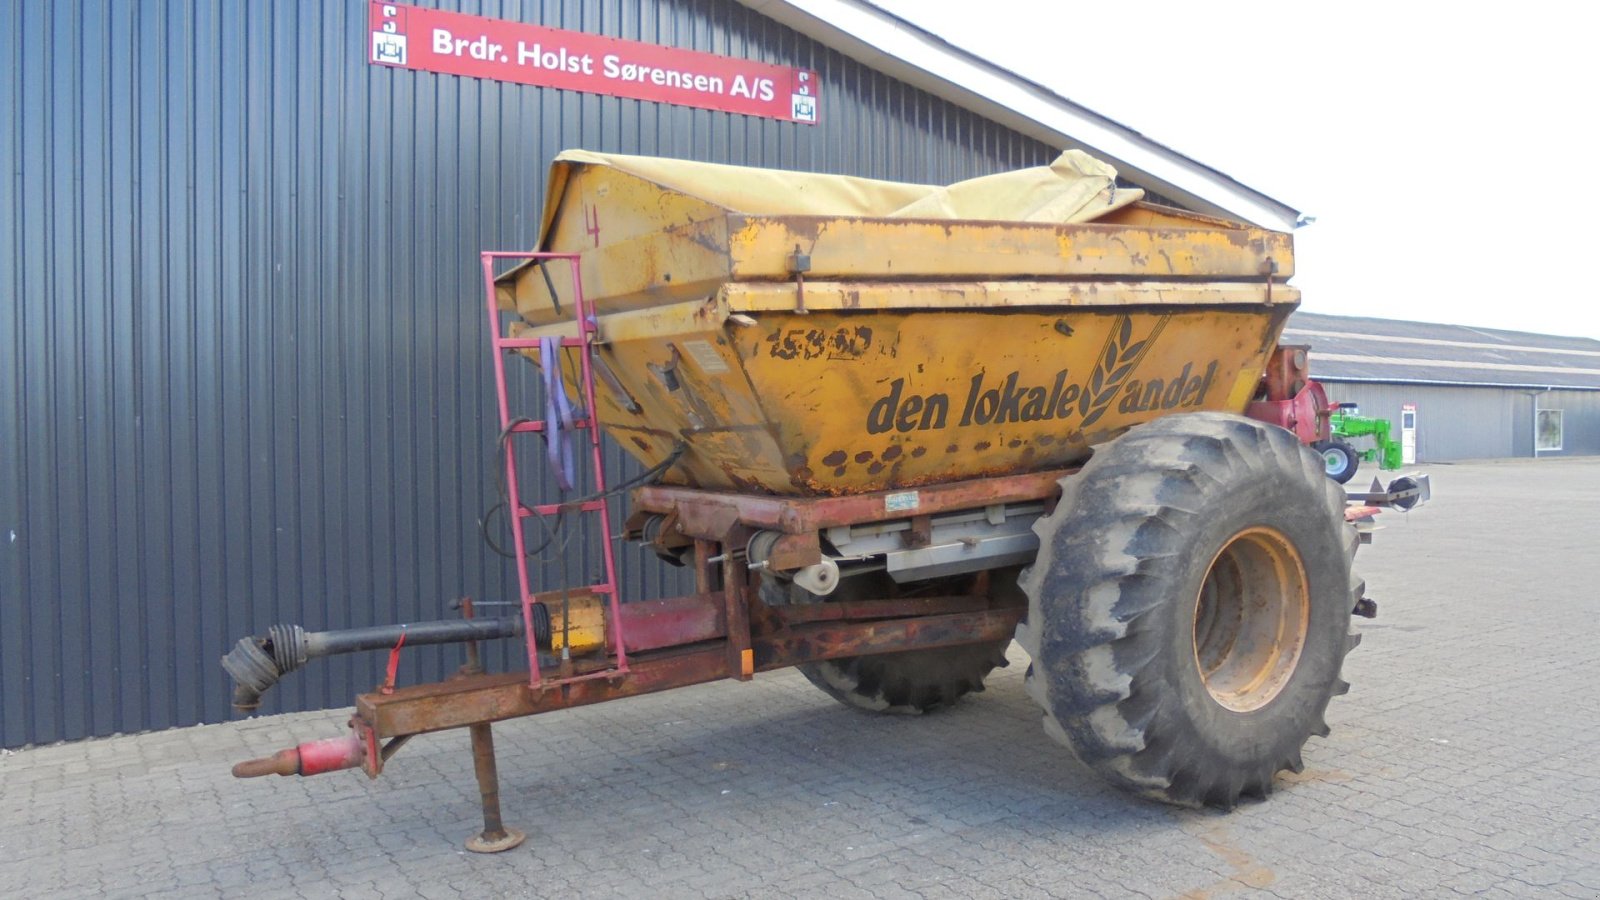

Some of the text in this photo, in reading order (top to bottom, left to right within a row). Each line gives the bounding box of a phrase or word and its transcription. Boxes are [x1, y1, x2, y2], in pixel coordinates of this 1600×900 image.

[432, 28, 775, 102] Brdr. Holst Sørensen A/S
[867, 361, 1217, 434] den lokale andel
